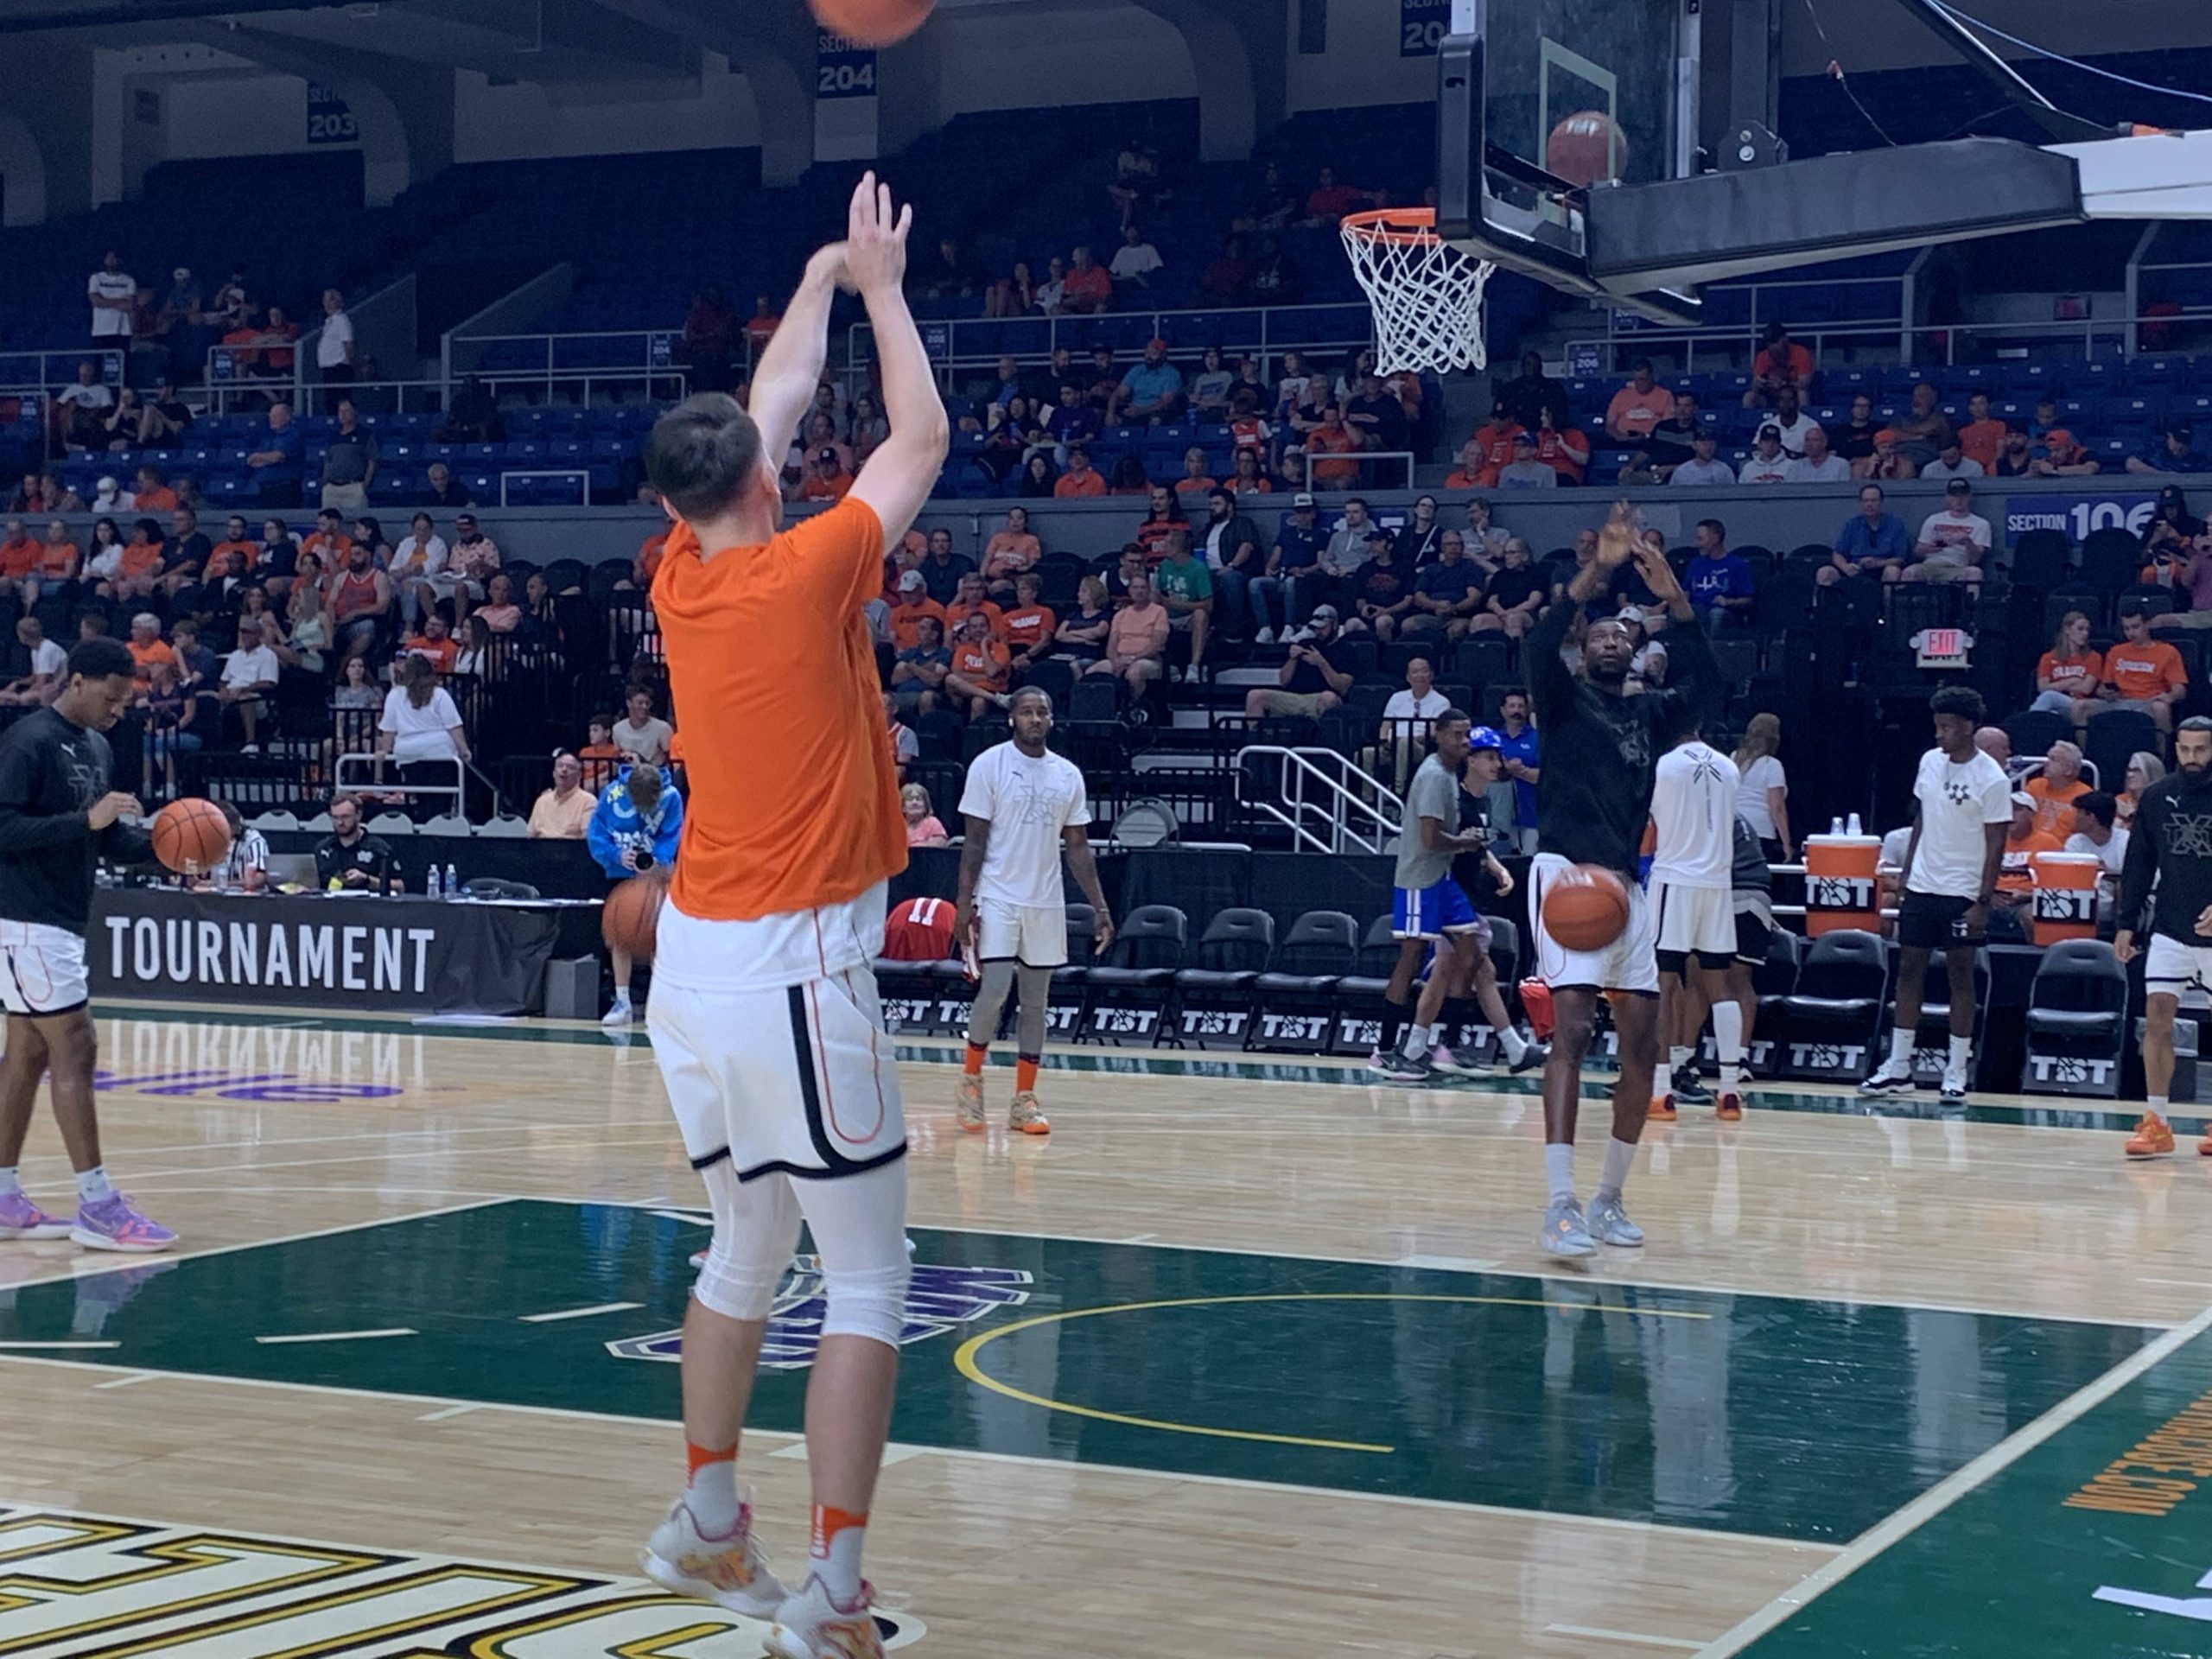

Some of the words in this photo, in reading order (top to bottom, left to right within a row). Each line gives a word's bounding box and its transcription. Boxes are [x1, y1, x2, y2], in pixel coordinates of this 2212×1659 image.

[1403, 21, 1451, 49] 20
[819, 64, 874, 92] 204
[310, 113, 356, 137] 203
[2007, 514, 2066, 531] SECTION
[1929, 632, 1958, 653] EXIT
[105, 916, 435, 993] TOURNAMENT
[1094, 1007, 1159, 1033] TST
[1181, 1010, 1249, 1035] TST
[1262, 1014, 1329, 1039] TST
[1789, 1043, 1866, 1070] TST
[2031, 1055, 2115, 1084] TST
